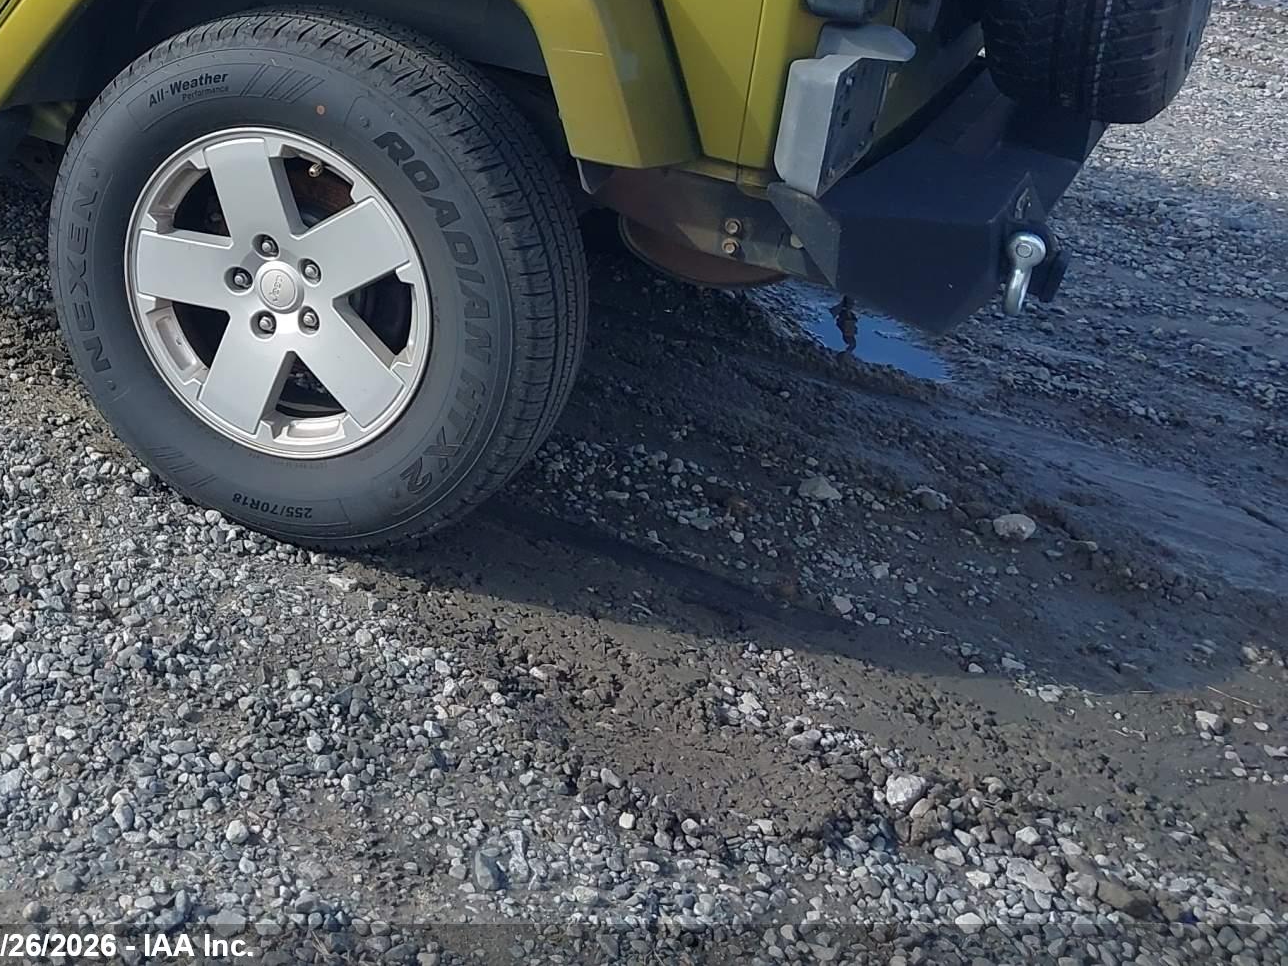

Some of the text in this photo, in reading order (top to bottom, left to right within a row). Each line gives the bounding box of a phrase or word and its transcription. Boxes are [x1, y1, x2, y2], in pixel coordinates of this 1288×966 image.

[149, 72, 229, 108] All-Weather
[181, 85, 230, 103] Performance
[372, 130, 493, 365] ROADIAN
[66, 181, 113, 374] NEXEN
[231, 492, 313, 520] 255/70R18
